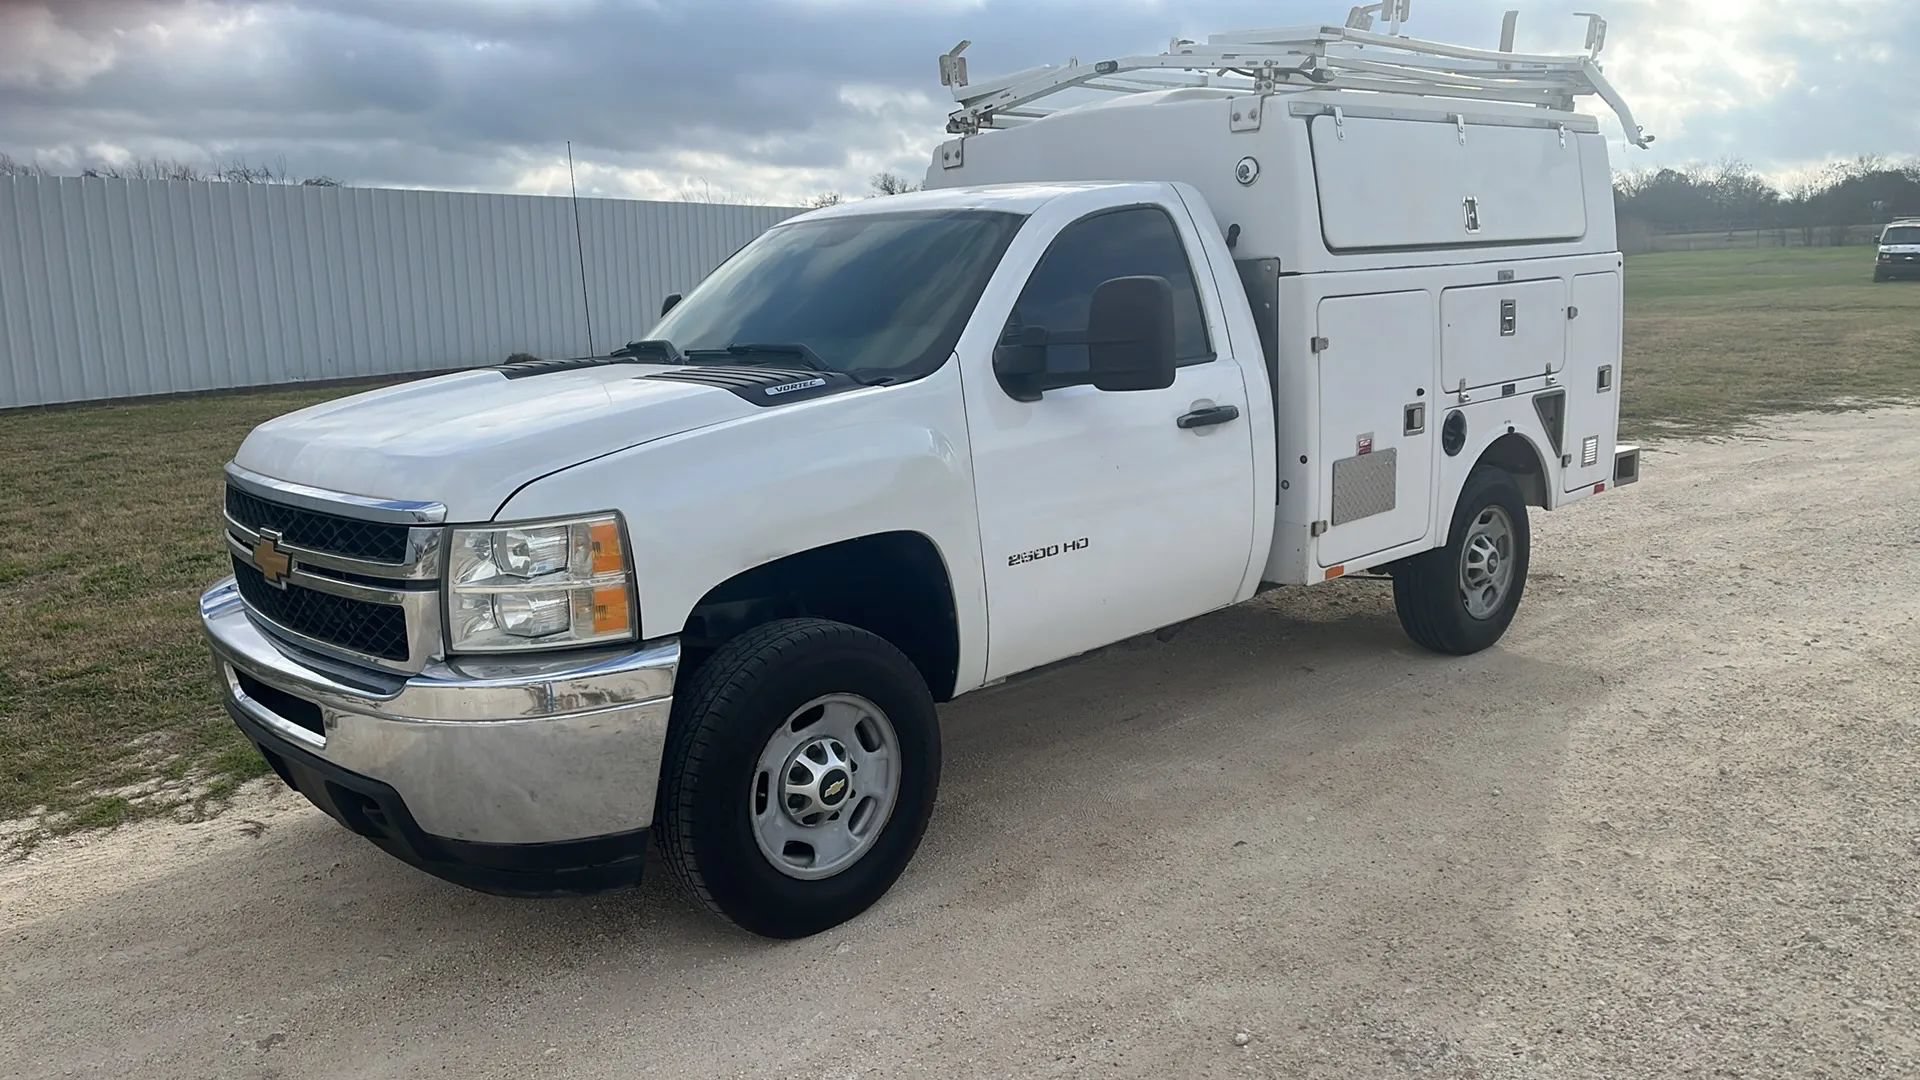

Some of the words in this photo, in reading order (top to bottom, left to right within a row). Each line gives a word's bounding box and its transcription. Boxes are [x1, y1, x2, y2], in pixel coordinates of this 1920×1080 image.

[775, 380, 817, 392] VORTEC
[1008, 545, 1059, 567] 2500
[1063, 537, 1089, 553] HD
